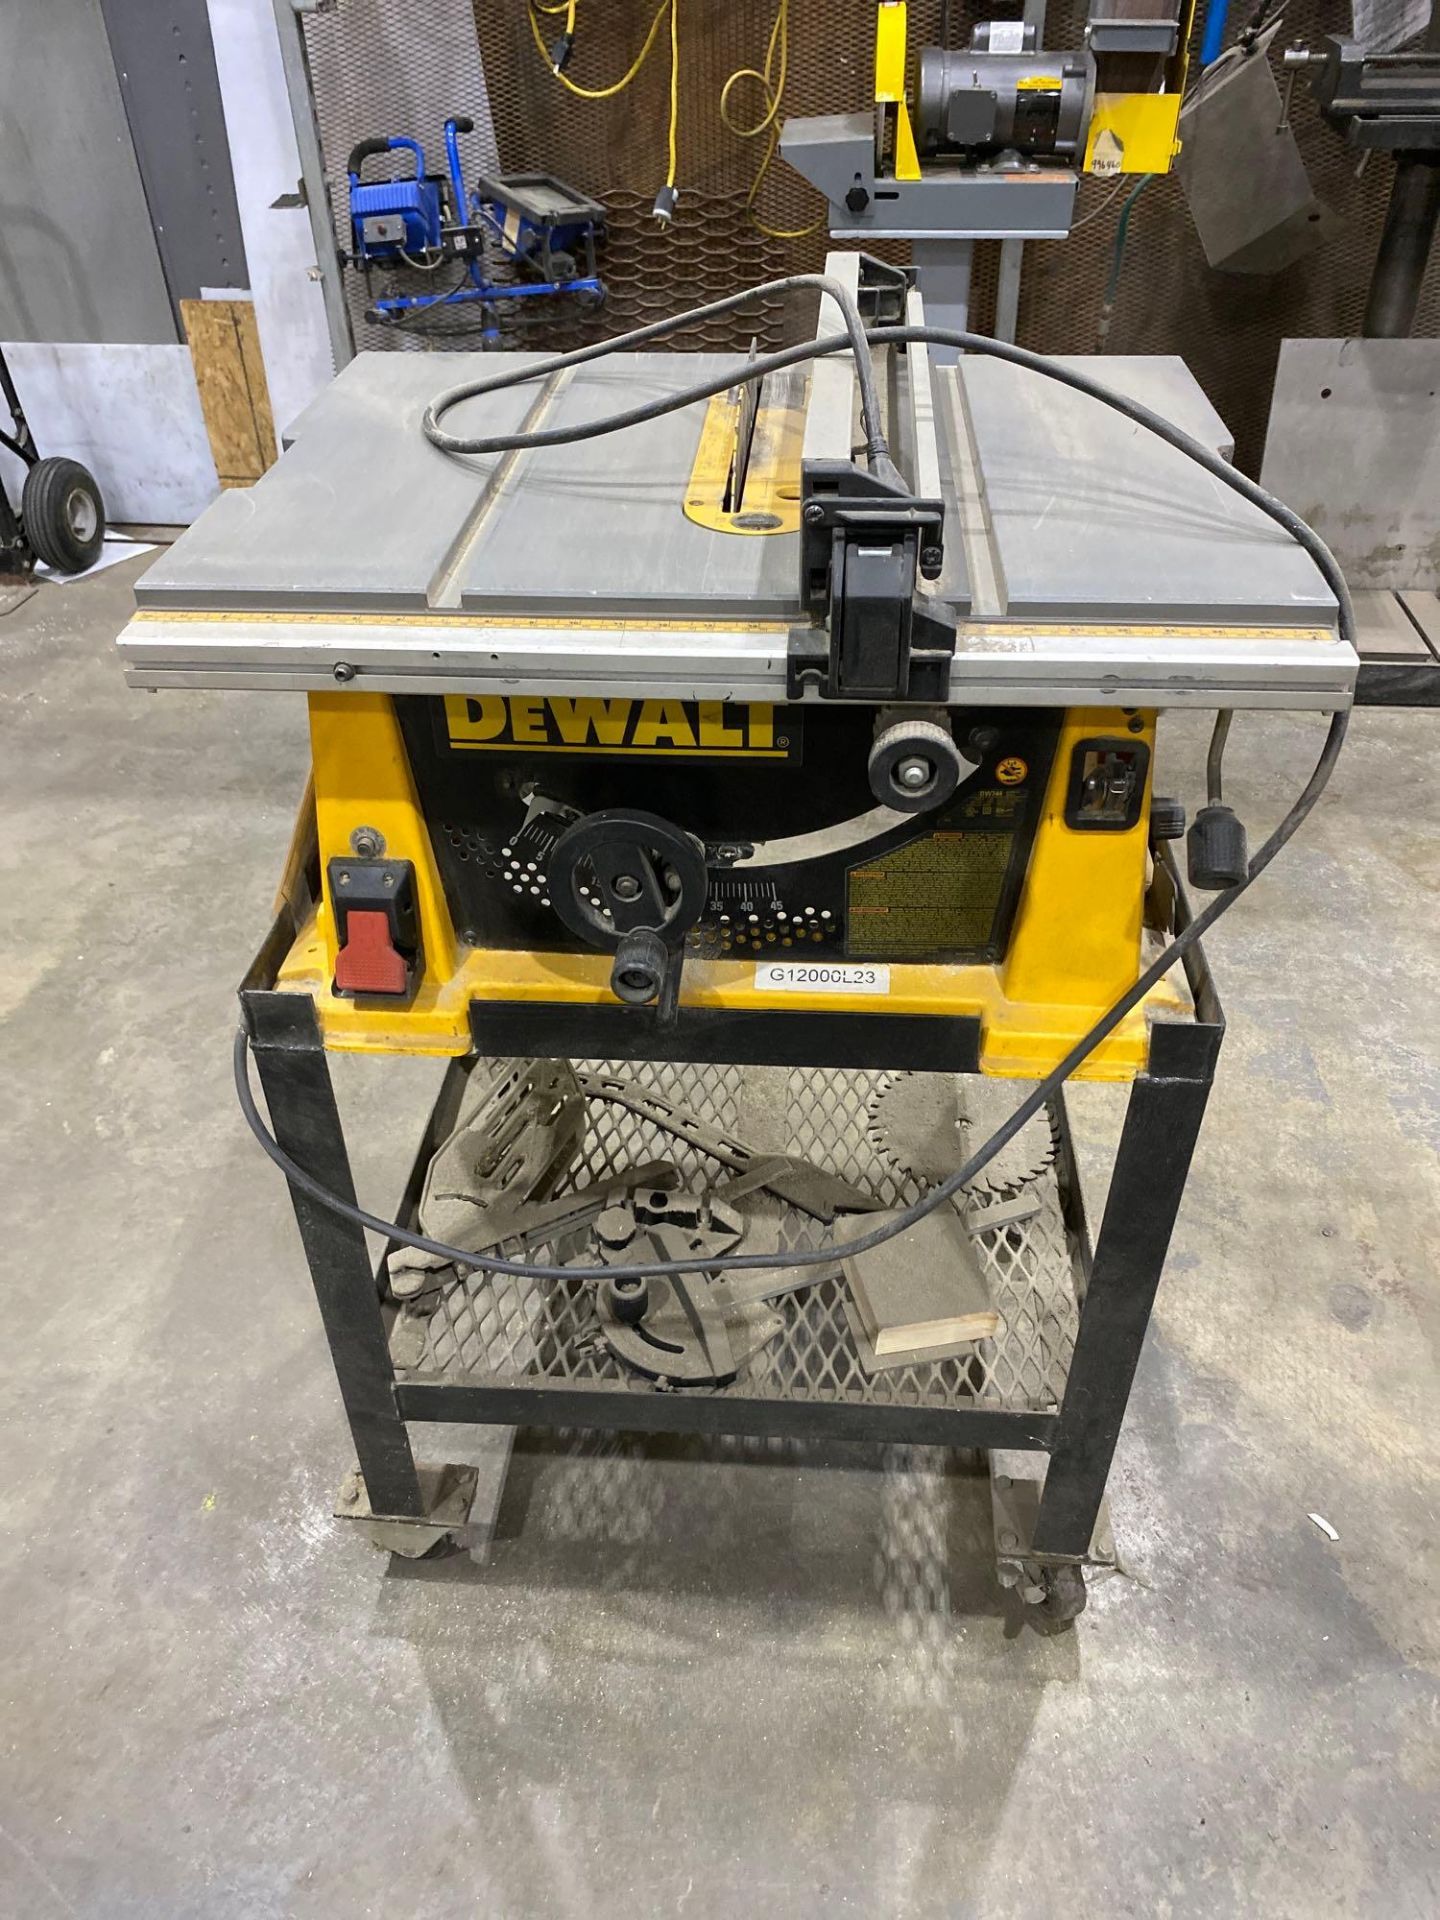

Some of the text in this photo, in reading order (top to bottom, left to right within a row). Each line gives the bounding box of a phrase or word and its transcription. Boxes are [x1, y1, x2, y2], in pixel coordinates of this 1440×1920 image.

[509, 836, 518, 846] 0
[536, 852, 545, 861] 5
[710, 901, 784, 912] 35 40 45
